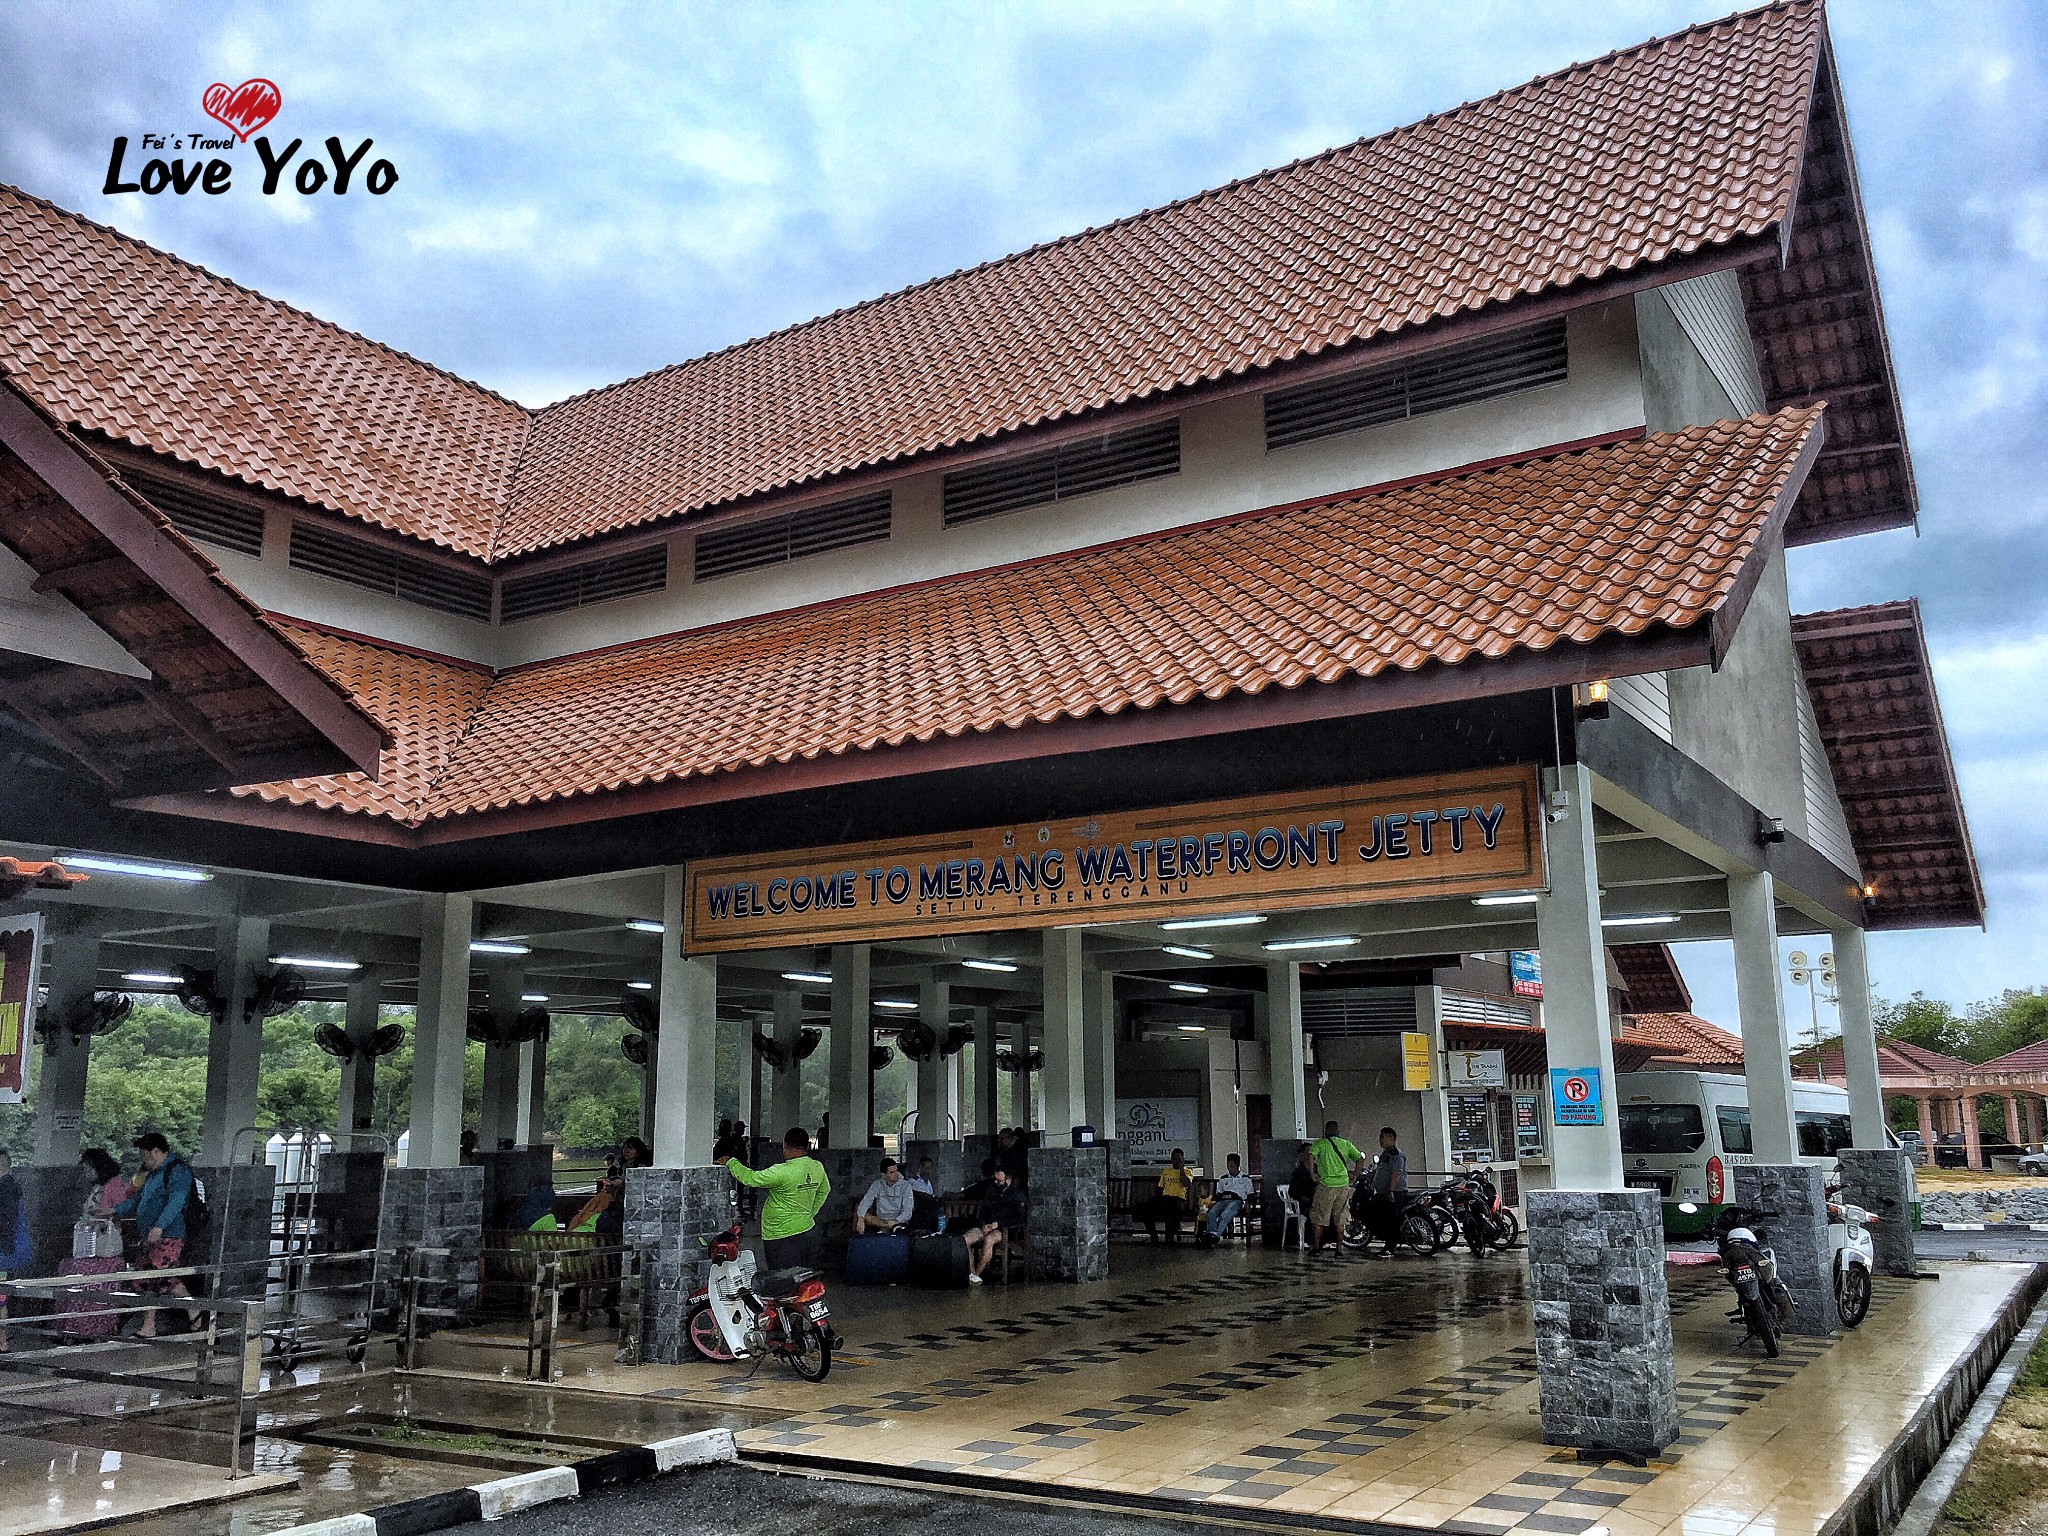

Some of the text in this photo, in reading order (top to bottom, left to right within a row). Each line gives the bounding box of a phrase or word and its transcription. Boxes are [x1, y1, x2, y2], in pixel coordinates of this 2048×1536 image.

[706, 803, 1504, 919] WELCOME TO MERANG WATERFRONT JETTY
[1017, 880, 1189, 908] TERENGGANU
